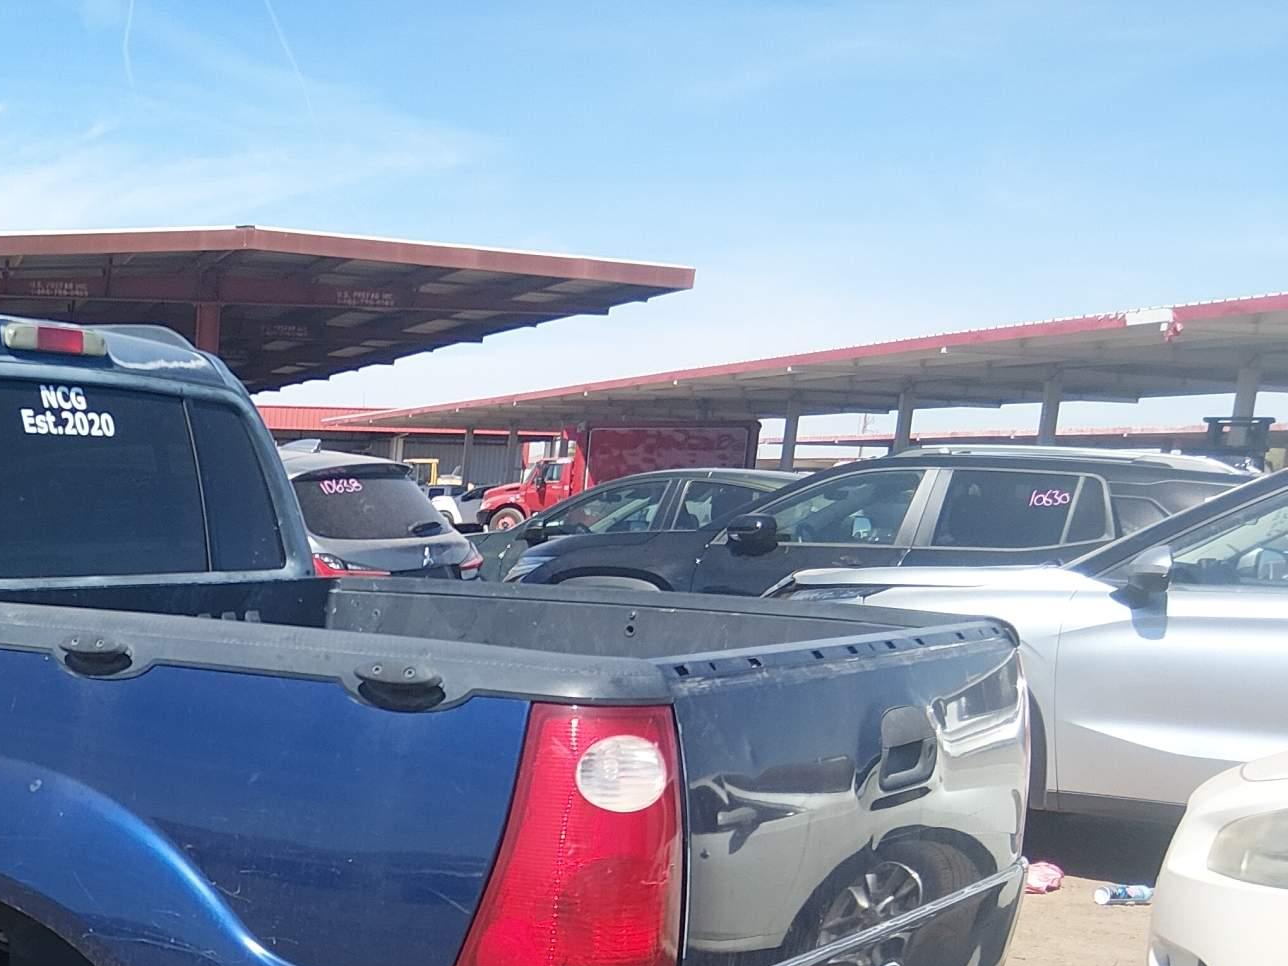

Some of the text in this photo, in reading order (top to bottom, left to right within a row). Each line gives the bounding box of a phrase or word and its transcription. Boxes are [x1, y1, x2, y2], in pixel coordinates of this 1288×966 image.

[40, 385, 88, 410] NCG
[20, 408, 115, 437] Est.2020
[1028, 489, 1070, 507] 10630
